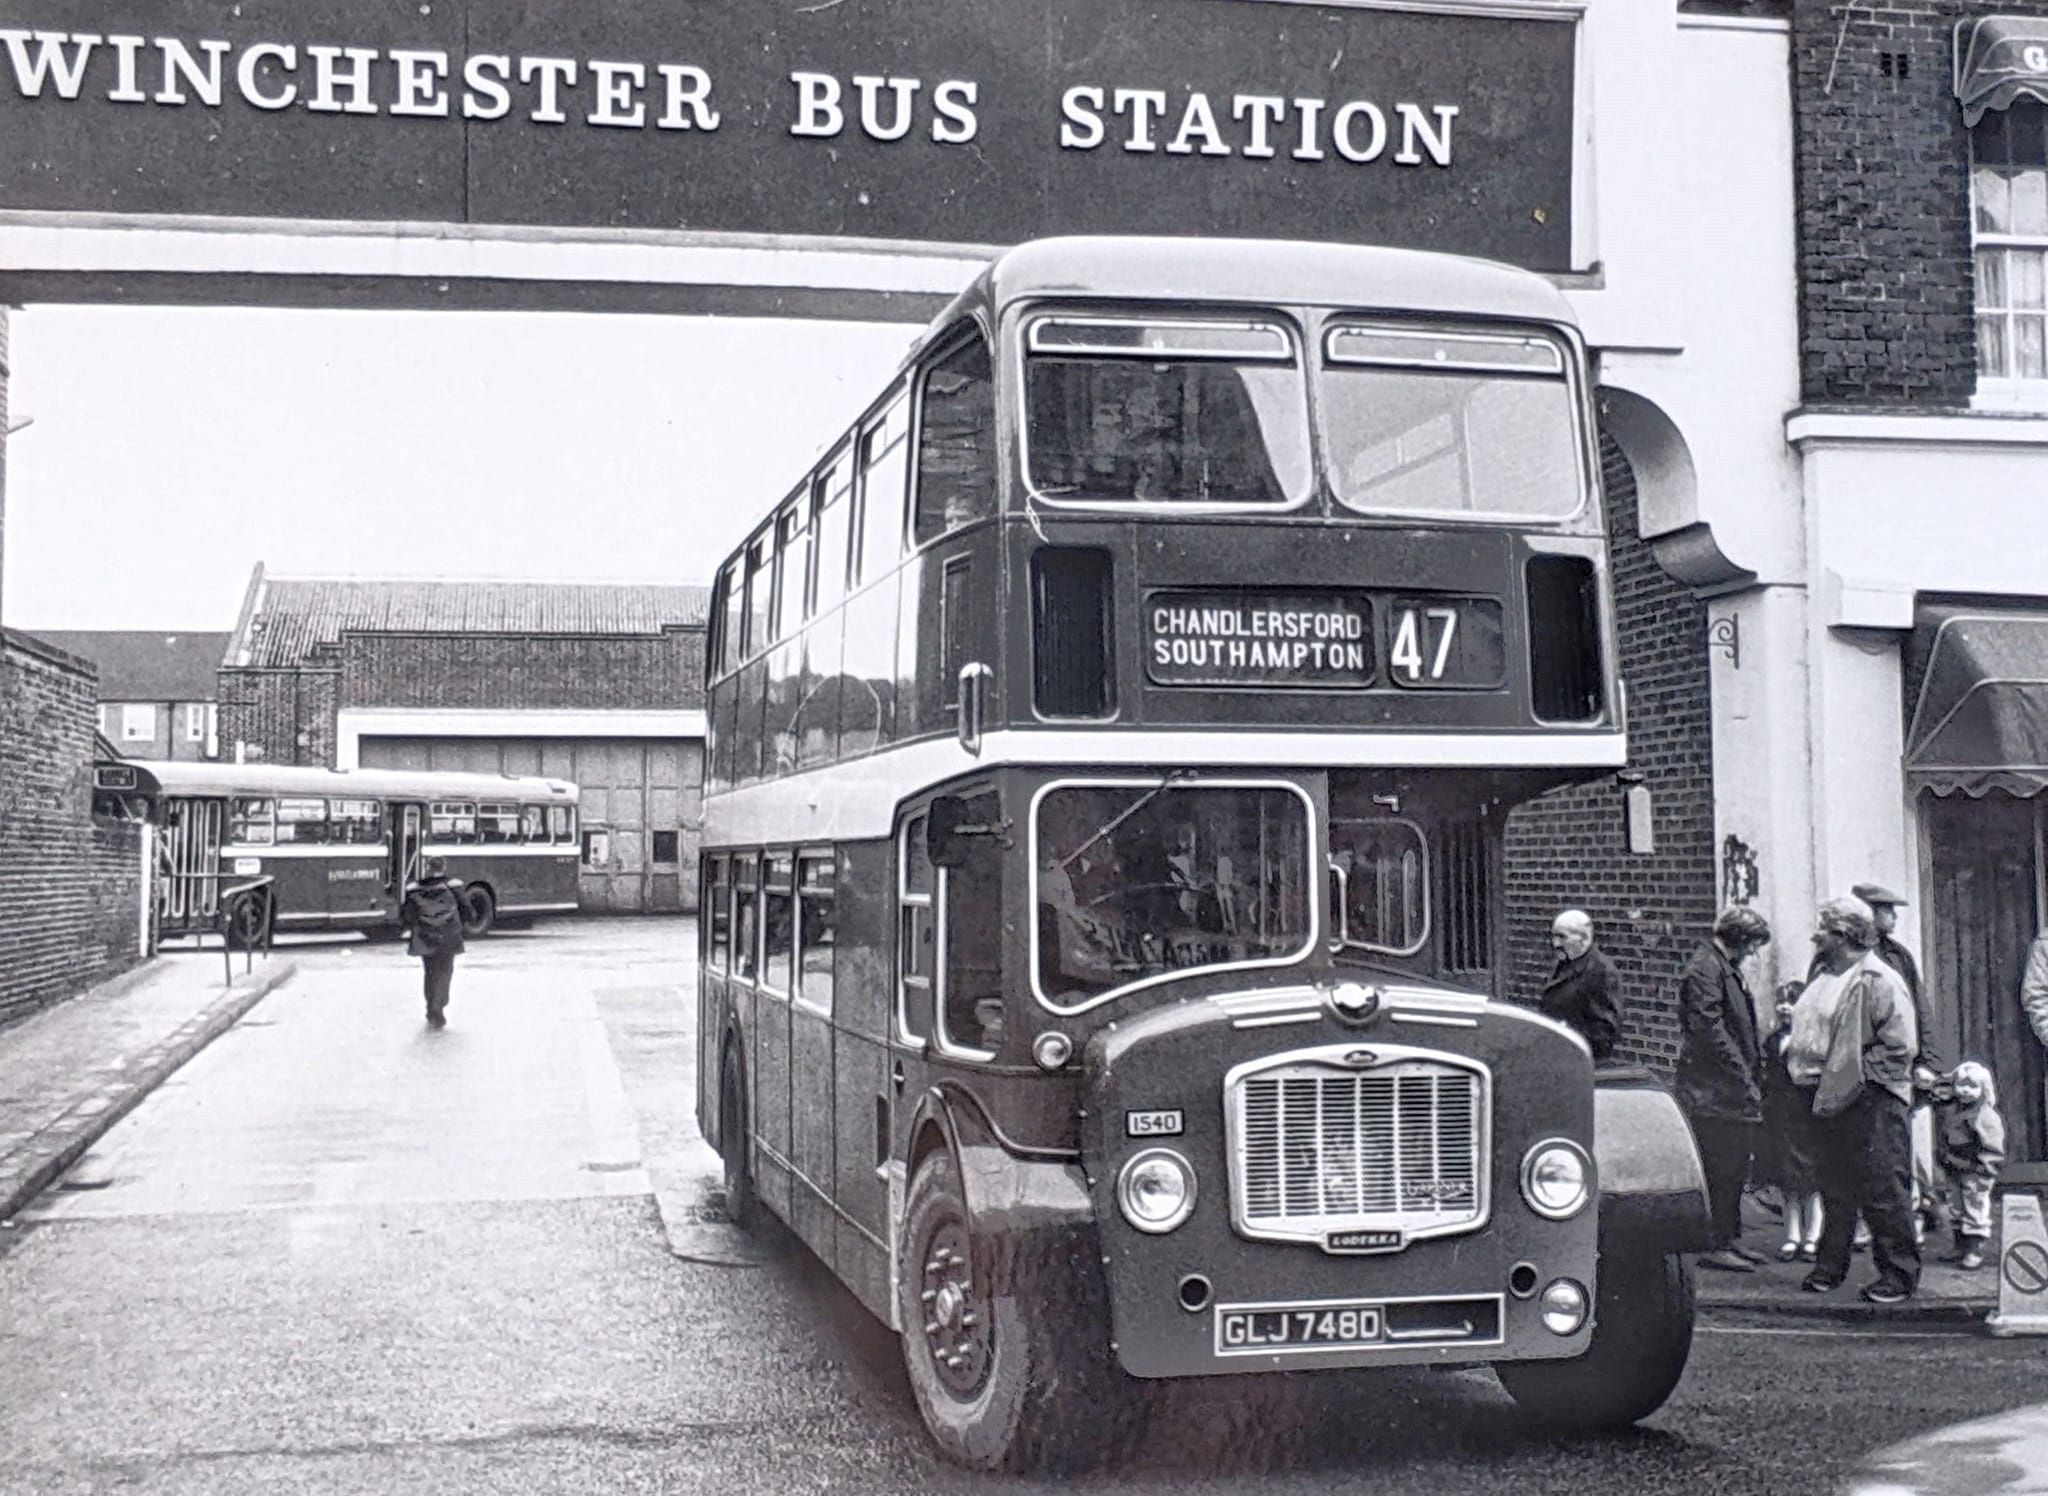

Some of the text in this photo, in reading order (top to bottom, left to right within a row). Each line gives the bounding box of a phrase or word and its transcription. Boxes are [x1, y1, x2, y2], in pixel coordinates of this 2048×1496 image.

[0, 29, 1460, 167] WINCHESTER BUS STATION
[1153, 608, 1362, 640] CHANDLERSFORD
[1155, 639, 1365, 670] SOUTHAMPTON
[1390, 608, 1457, 680] 47
[1133, 1114, 1177, 1132] 1540
